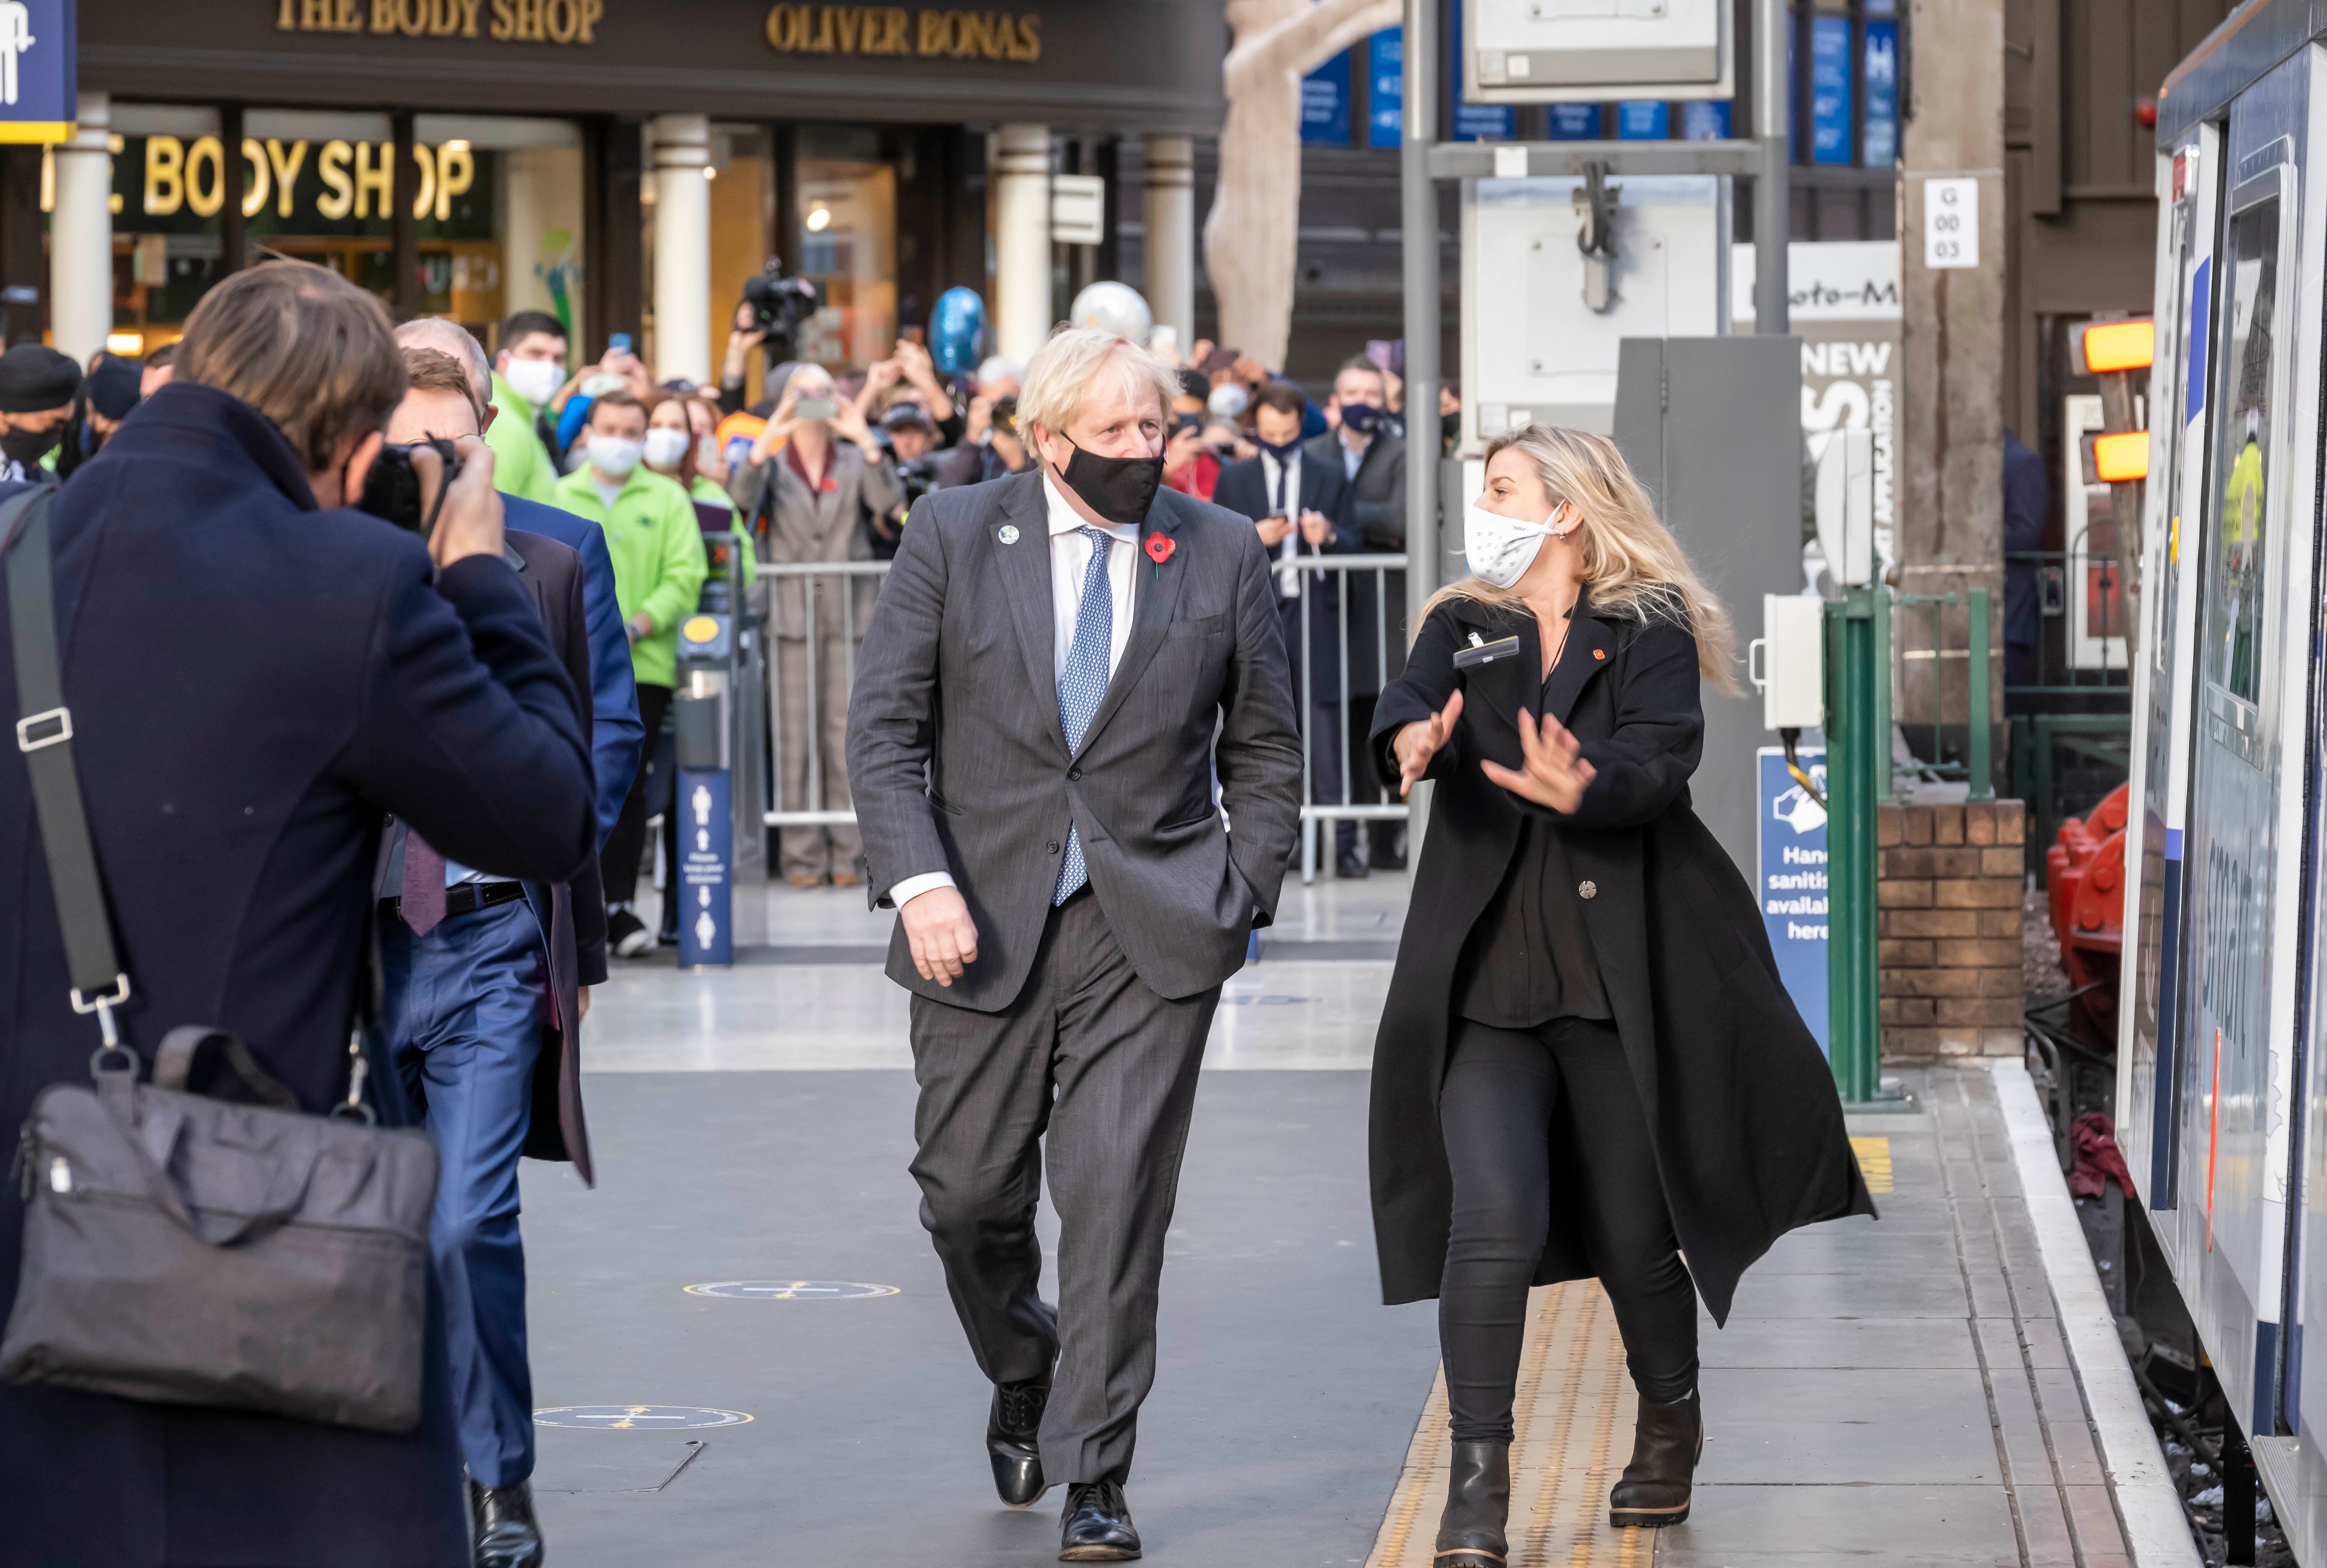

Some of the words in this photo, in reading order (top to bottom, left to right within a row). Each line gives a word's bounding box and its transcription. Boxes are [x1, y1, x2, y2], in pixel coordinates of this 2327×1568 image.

[369, 0, 480, 37] BODY
[490, 0, 603, 44] SHOP
[765, 2, 911, 54] OLIVER
[917, 9, 1041, 62] BONAS
[1940, 187, 1958, 205] G
[1934, 213, 1959, 233] 00
[1800, 341, 1892, 376] NEW
[2203, 828, 2253, 1060] smart
